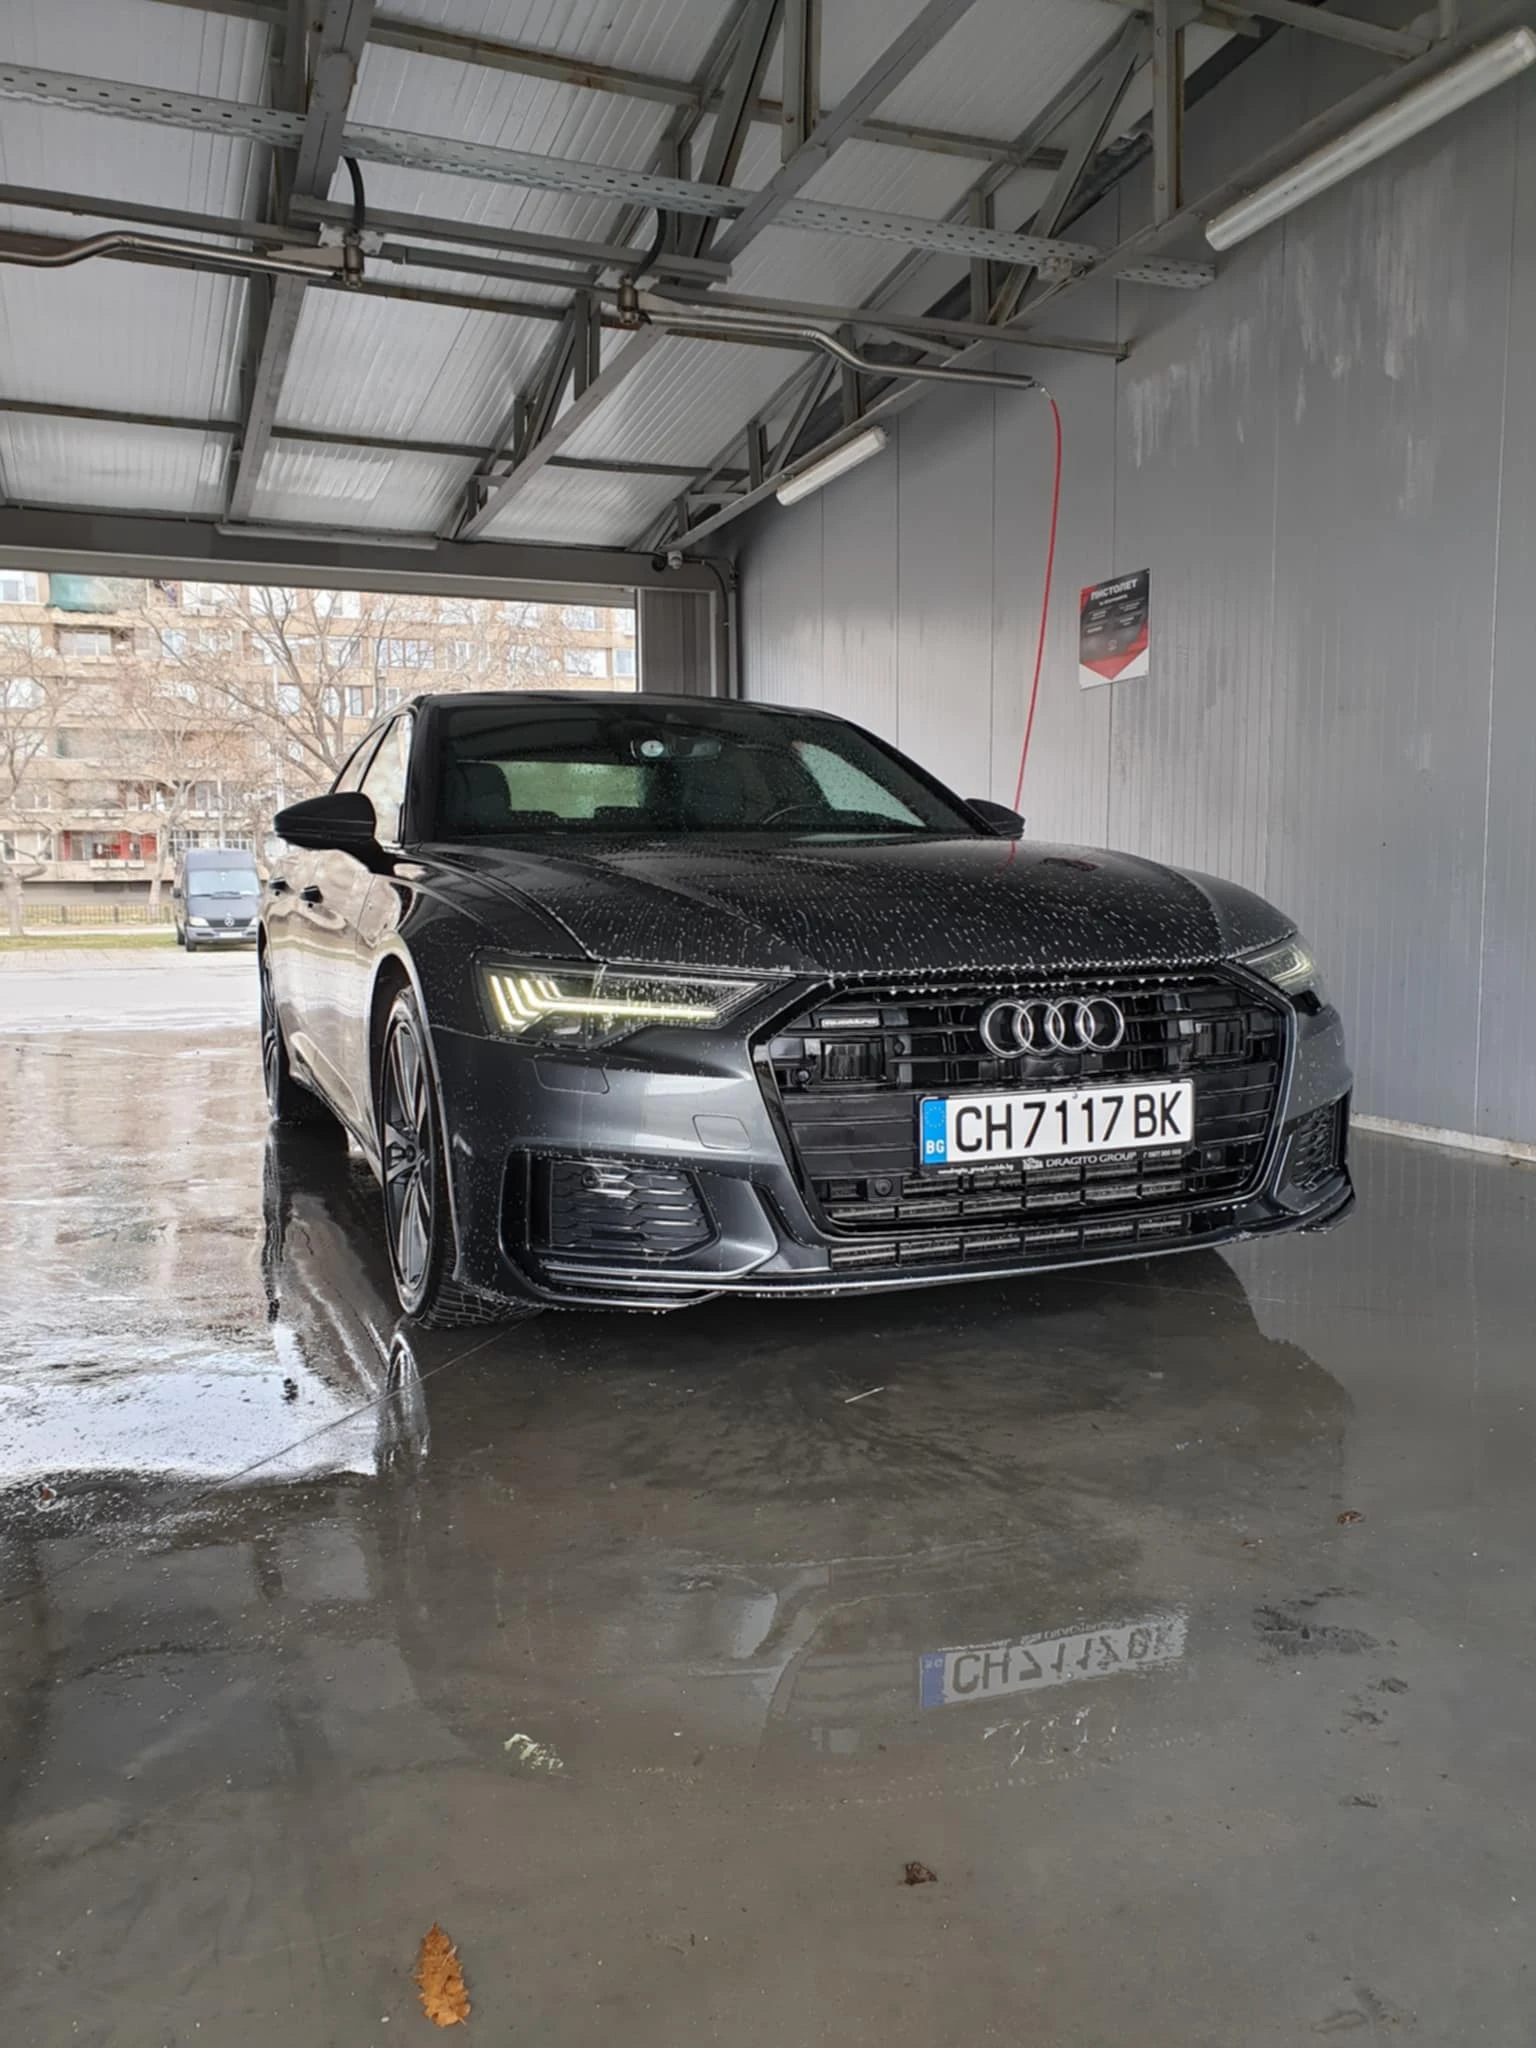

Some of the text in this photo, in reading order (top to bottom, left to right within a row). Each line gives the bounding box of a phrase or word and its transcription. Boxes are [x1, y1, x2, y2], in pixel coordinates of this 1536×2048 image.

[926, 1139, 945, 1155] BG
[1046, 1156, 1098, 1168] DRAGITO
[1099, 1151, 1137, 1164] GROUP
